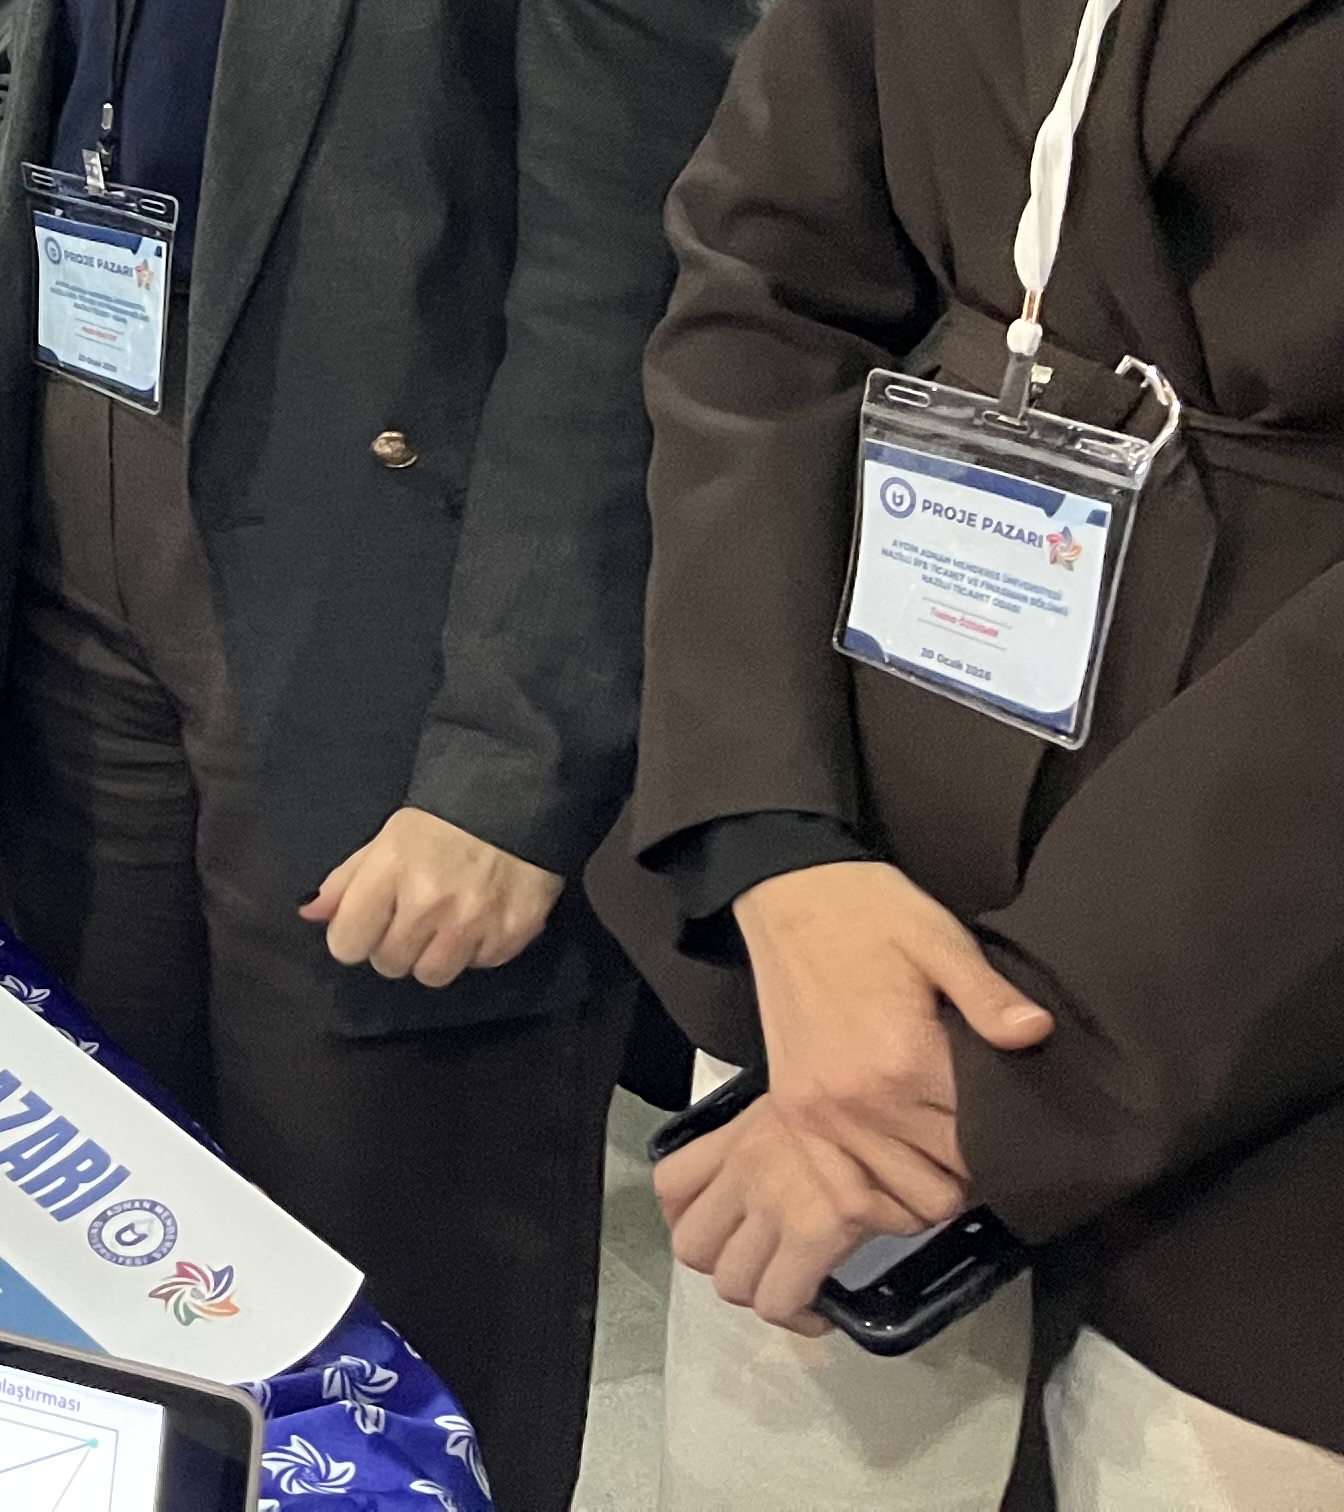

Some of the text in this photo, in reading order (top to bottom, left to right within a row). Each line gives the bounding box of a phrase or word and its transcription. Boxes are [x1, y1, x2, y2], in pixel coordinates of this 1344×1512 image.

[64, 250, 132, 276] PROJE PAZARI
[921, 500, 1043, 546] PROJE PAZARI
